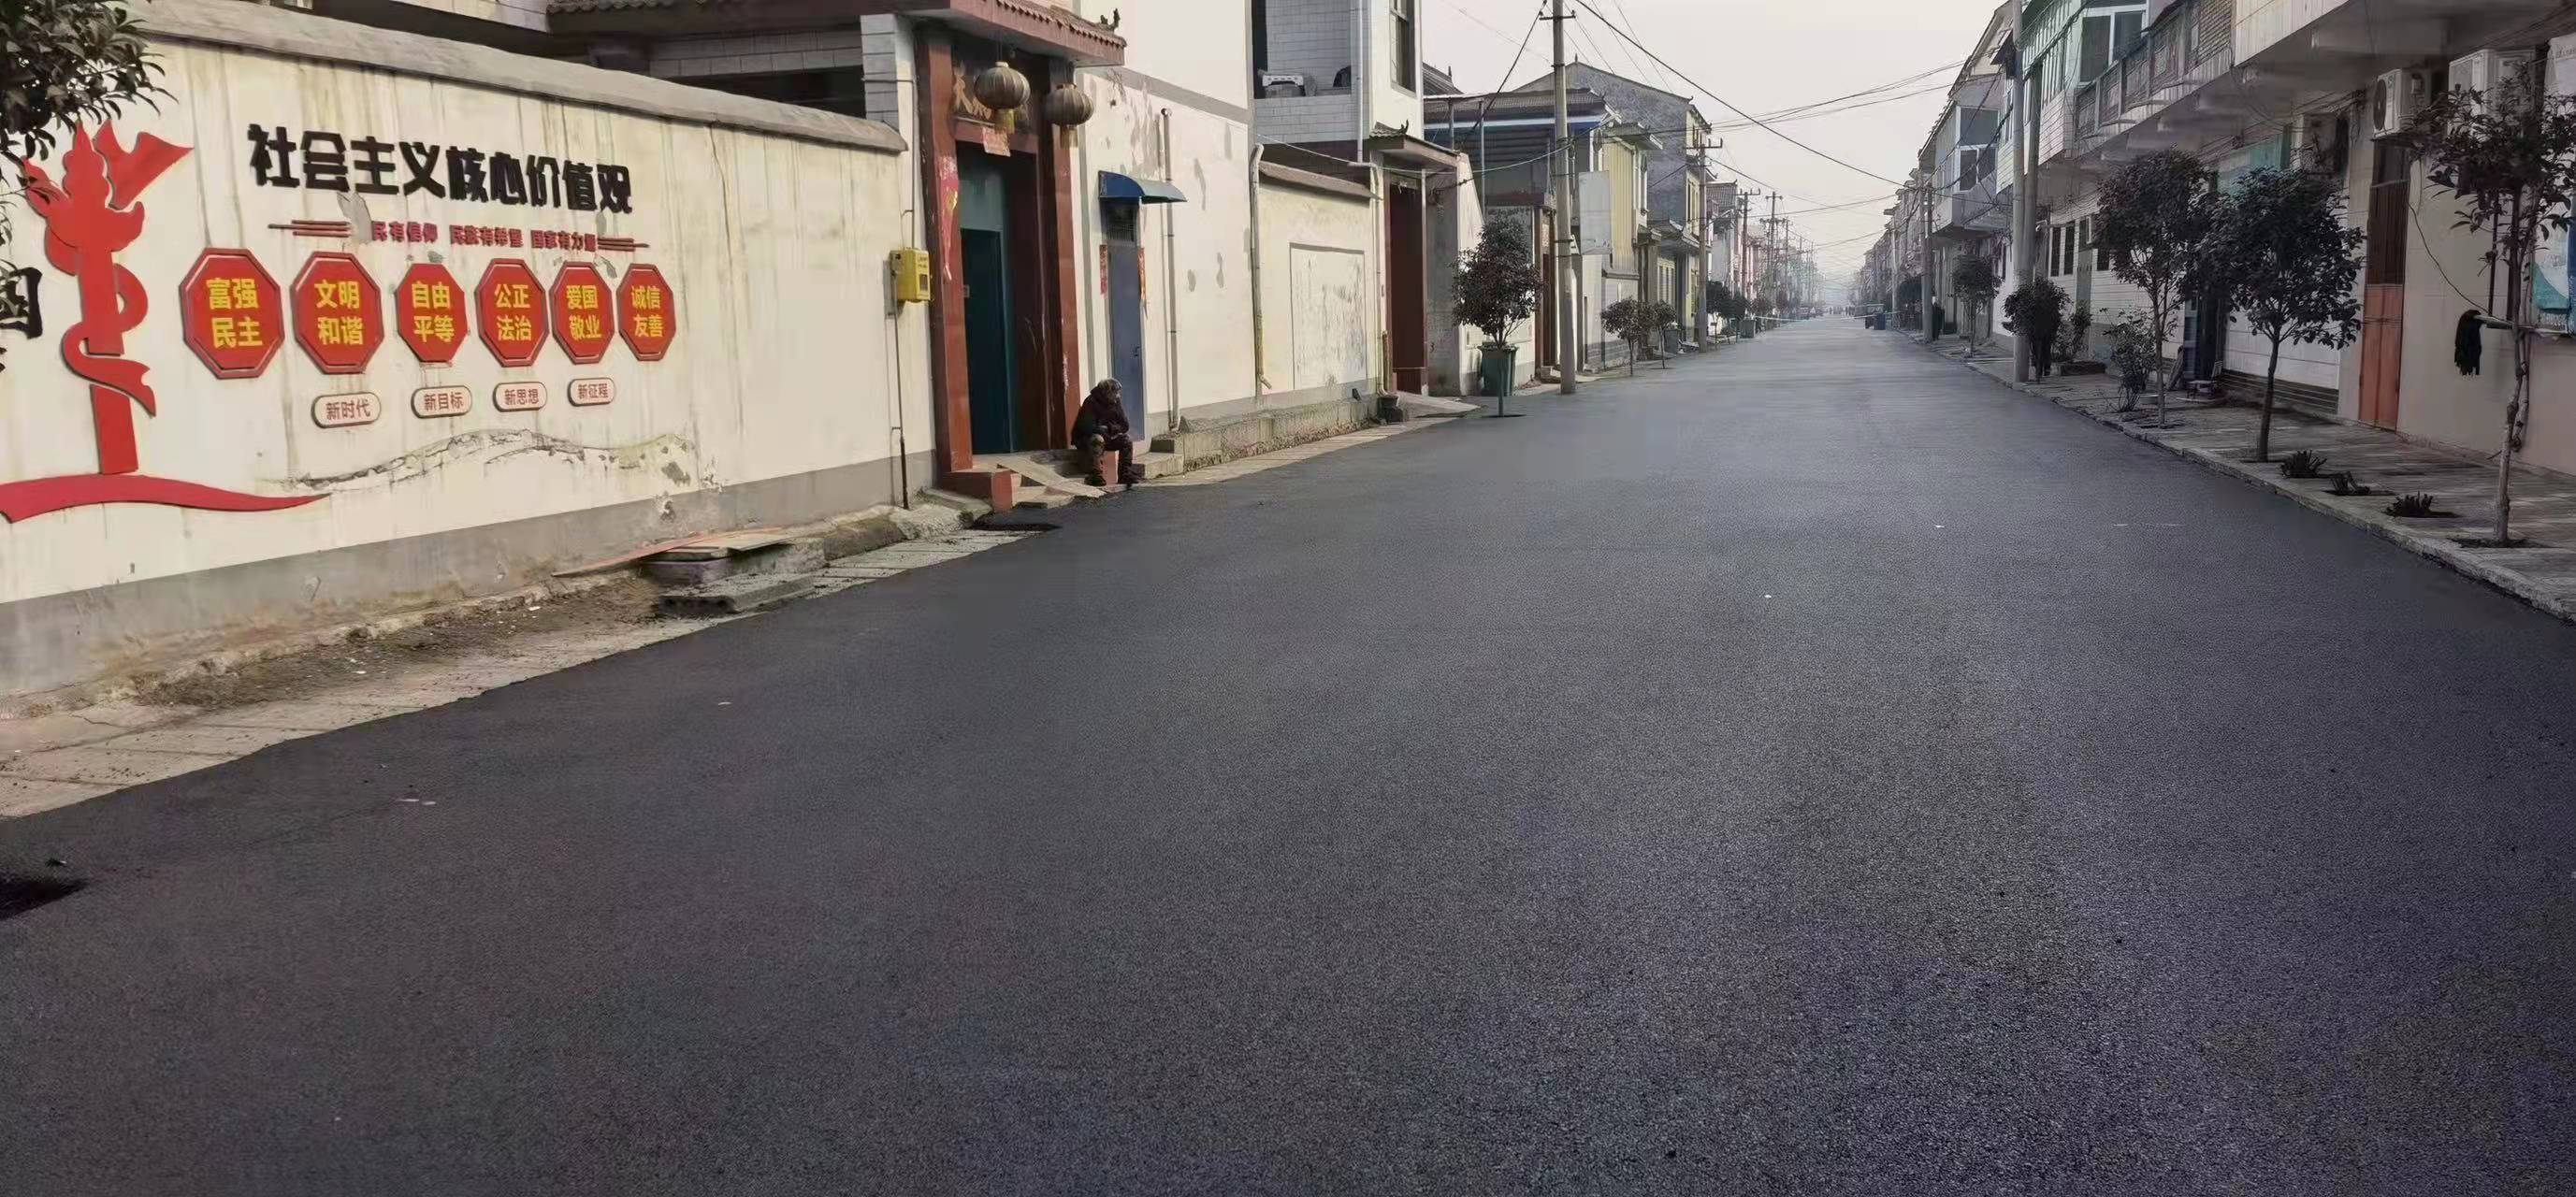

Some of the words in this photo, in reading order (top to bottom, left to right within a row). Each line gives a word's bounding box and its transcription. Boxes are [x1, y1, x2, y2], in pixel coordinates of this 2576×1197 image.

[248, 123, 632, 214] 社会主义核心价值观
[449, 224, 523, 248] 民族有希望
[206, 278, 259, 310] 富强
[314, 280, 360, 309] 文明
[412, 281, 451, 309] 自由
[495, 283, 530, 309] 公正
[566, 285, 599, 310] 爱国
[630, 285, 661, 310] 诚信
[211, 317, 263, 349] 民主
[317, 316, 364, 345] 和谐
[413, 315, 455, 343] 平等
[497, 315, 532, 341] 法治
[569, 314, 602, 340] 敬业
[633, 314, 665, 338] 友善
[424, 392, 464, 411] 新目标
[504, 388, 539, 405] 新思想
[577, 382, 608, 399] 新征程
[326, 398, 371, 420] 新时代
